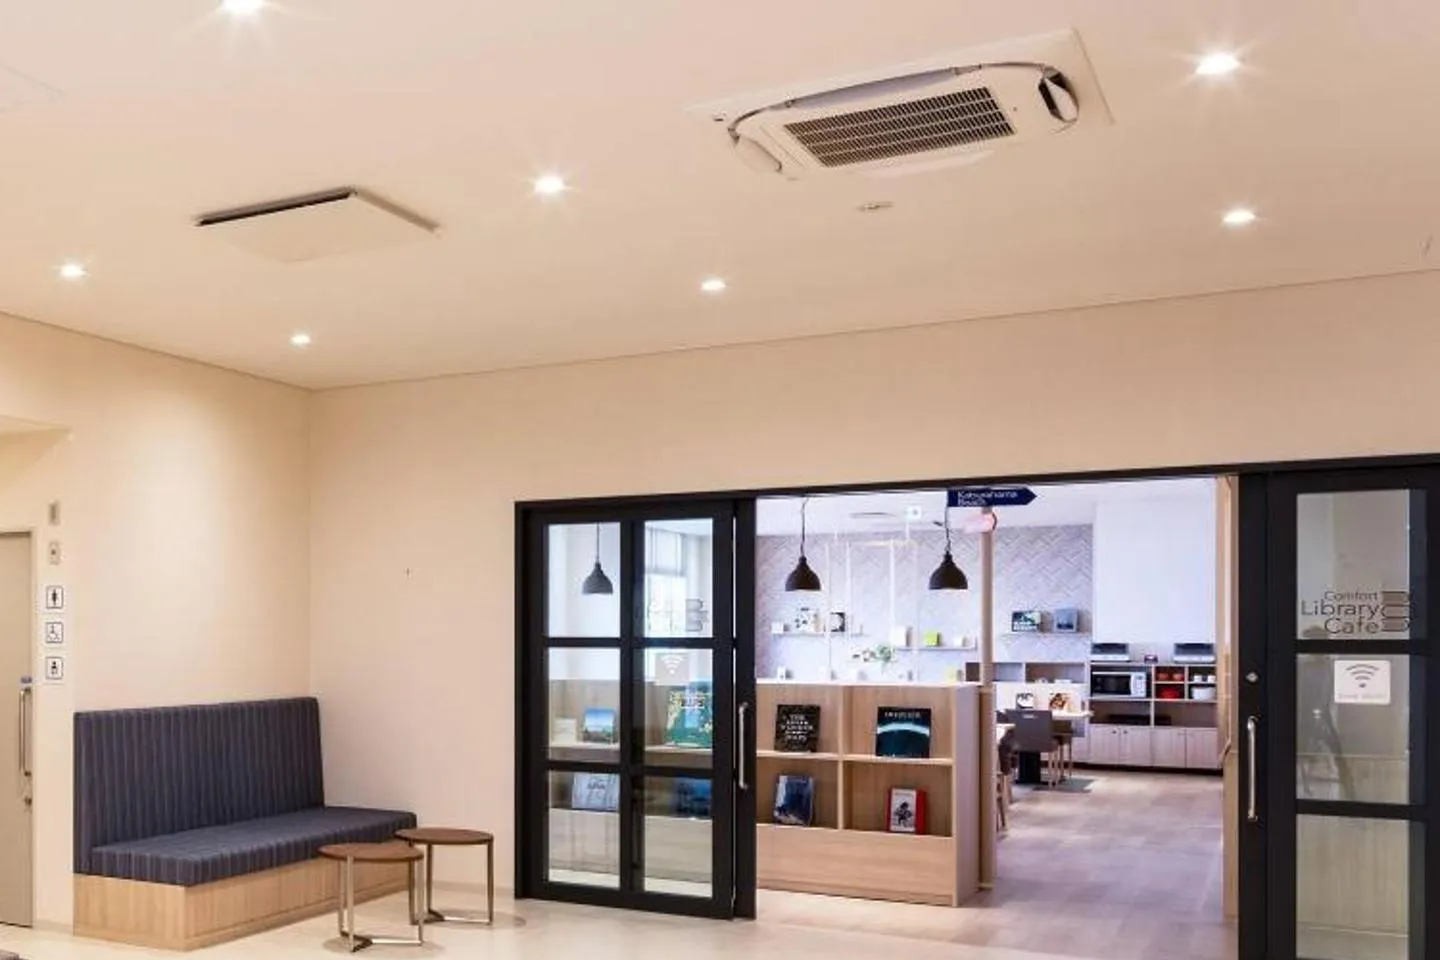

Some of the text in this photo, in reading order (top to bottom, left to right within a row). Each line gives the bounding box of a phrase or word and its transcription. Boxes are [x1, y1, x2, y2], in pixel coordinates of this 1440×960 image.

[1324, 591, 1378, 601] Comfort
[1301, 599, 1380, 620] Library
[1324, 616, 1380, 634] Cafe
